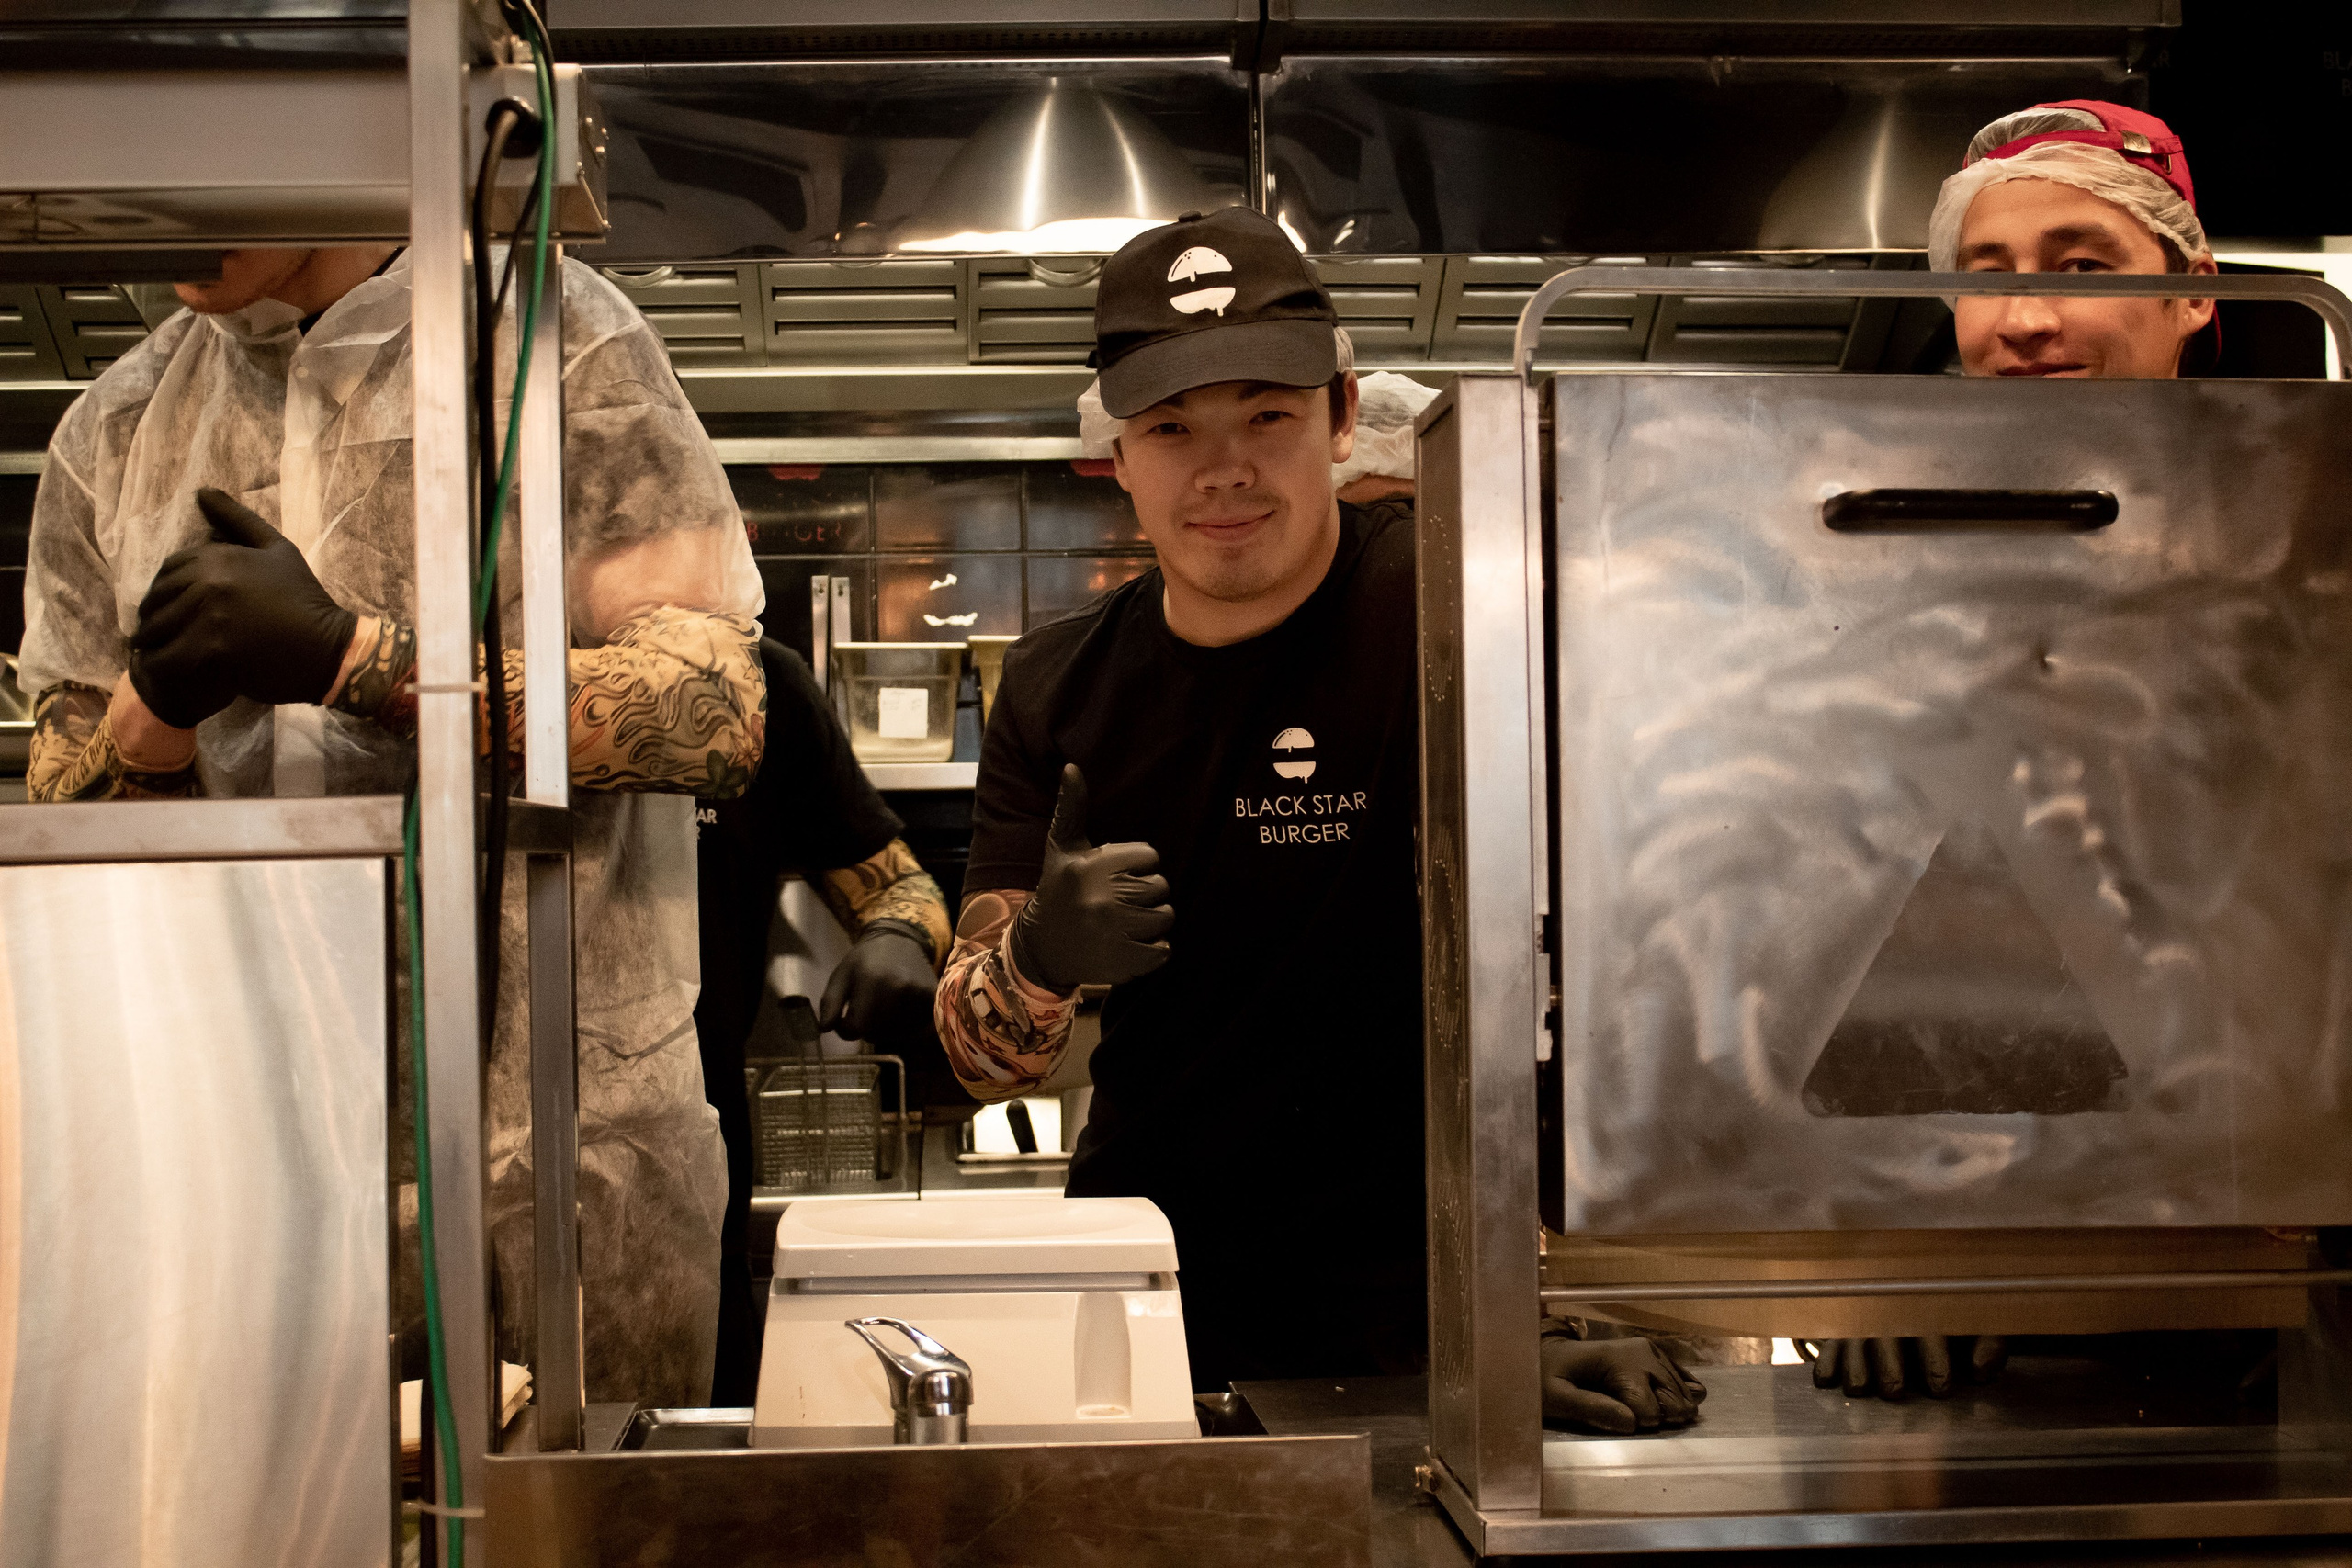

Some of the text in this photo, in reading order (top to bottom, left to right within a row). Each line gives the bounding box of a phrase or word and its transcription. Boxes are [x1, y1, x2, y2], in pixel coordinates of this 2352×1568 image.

[1236, 791, 1367, 817] BLACK STAR
[1260, 822, 1351, 844] BURGER
